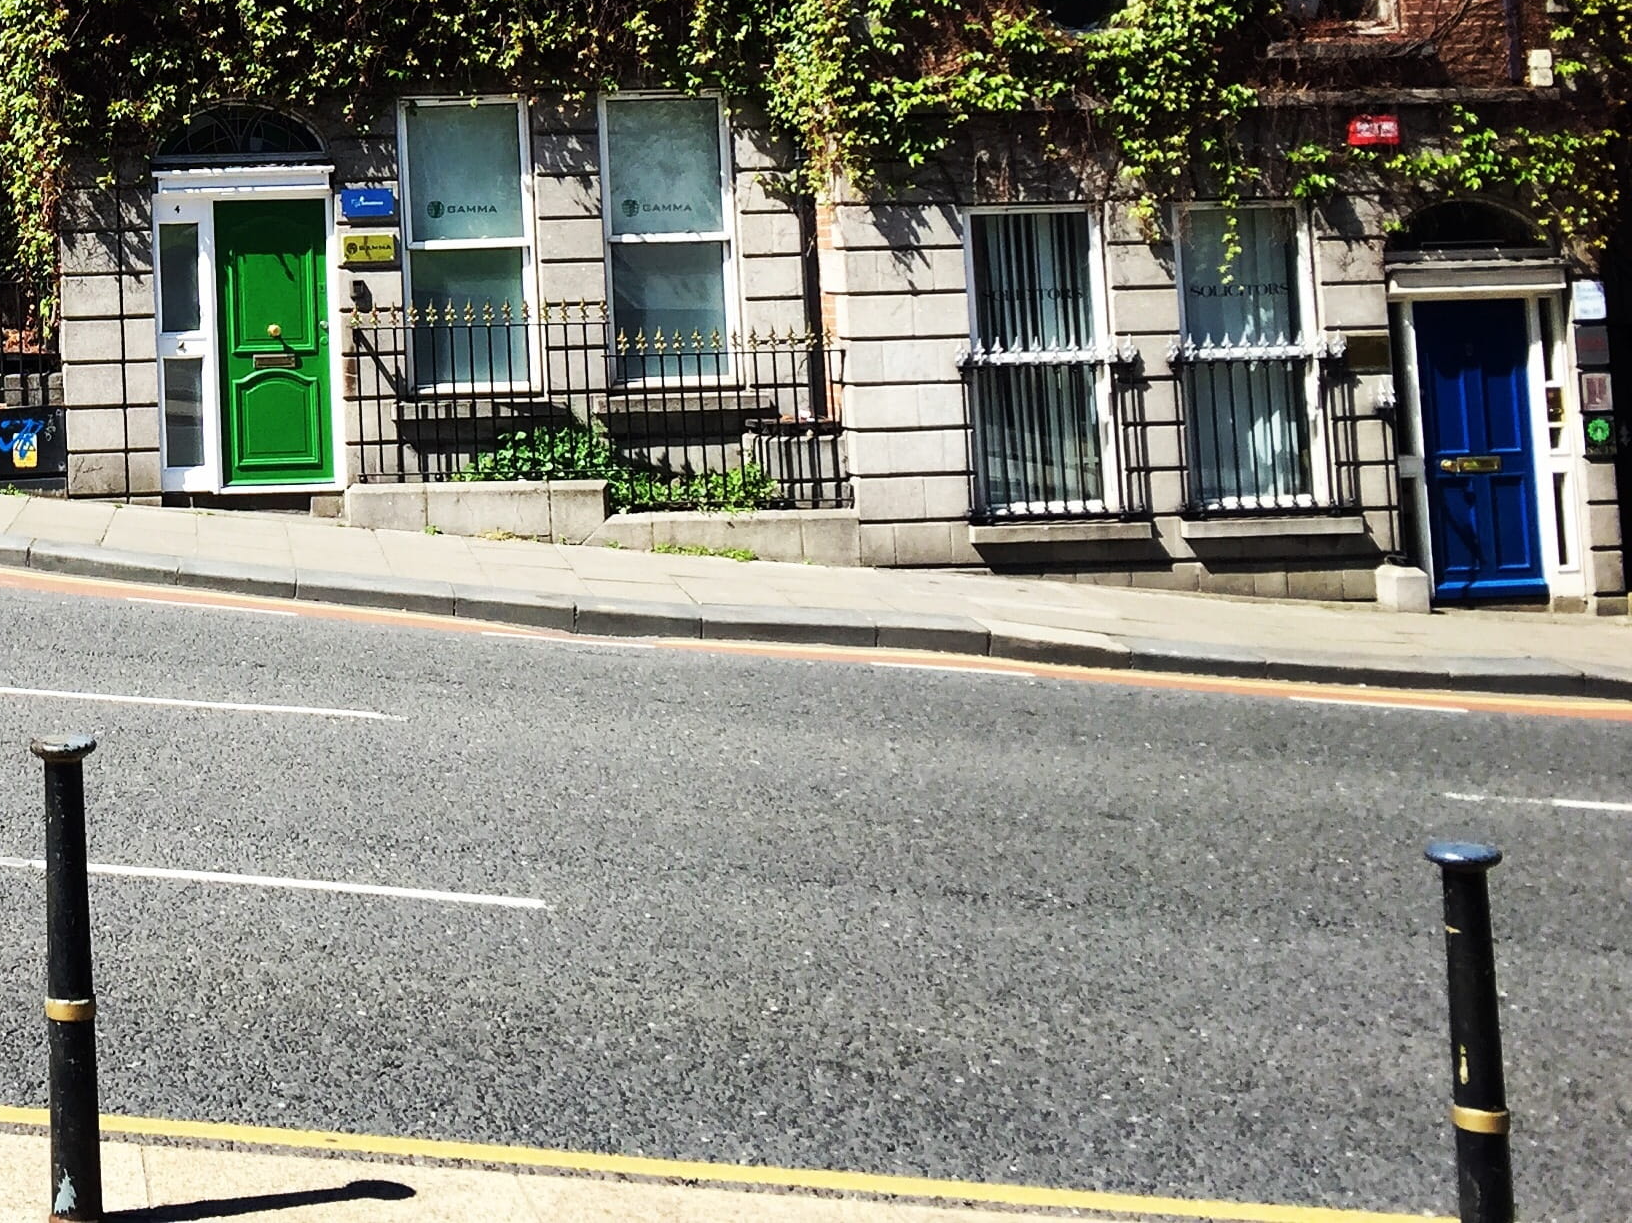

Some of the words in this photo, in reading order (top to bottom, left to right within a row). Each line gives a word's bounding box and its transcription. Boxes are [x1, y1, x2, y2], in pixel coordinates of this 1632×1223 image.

[174, 205, 180, 214] 4
[447, 205, 497, 214] GAMMA
[642, 204, 692, 212] GAMMA
[1189, 282, 1290, 298] SOLICITORS
